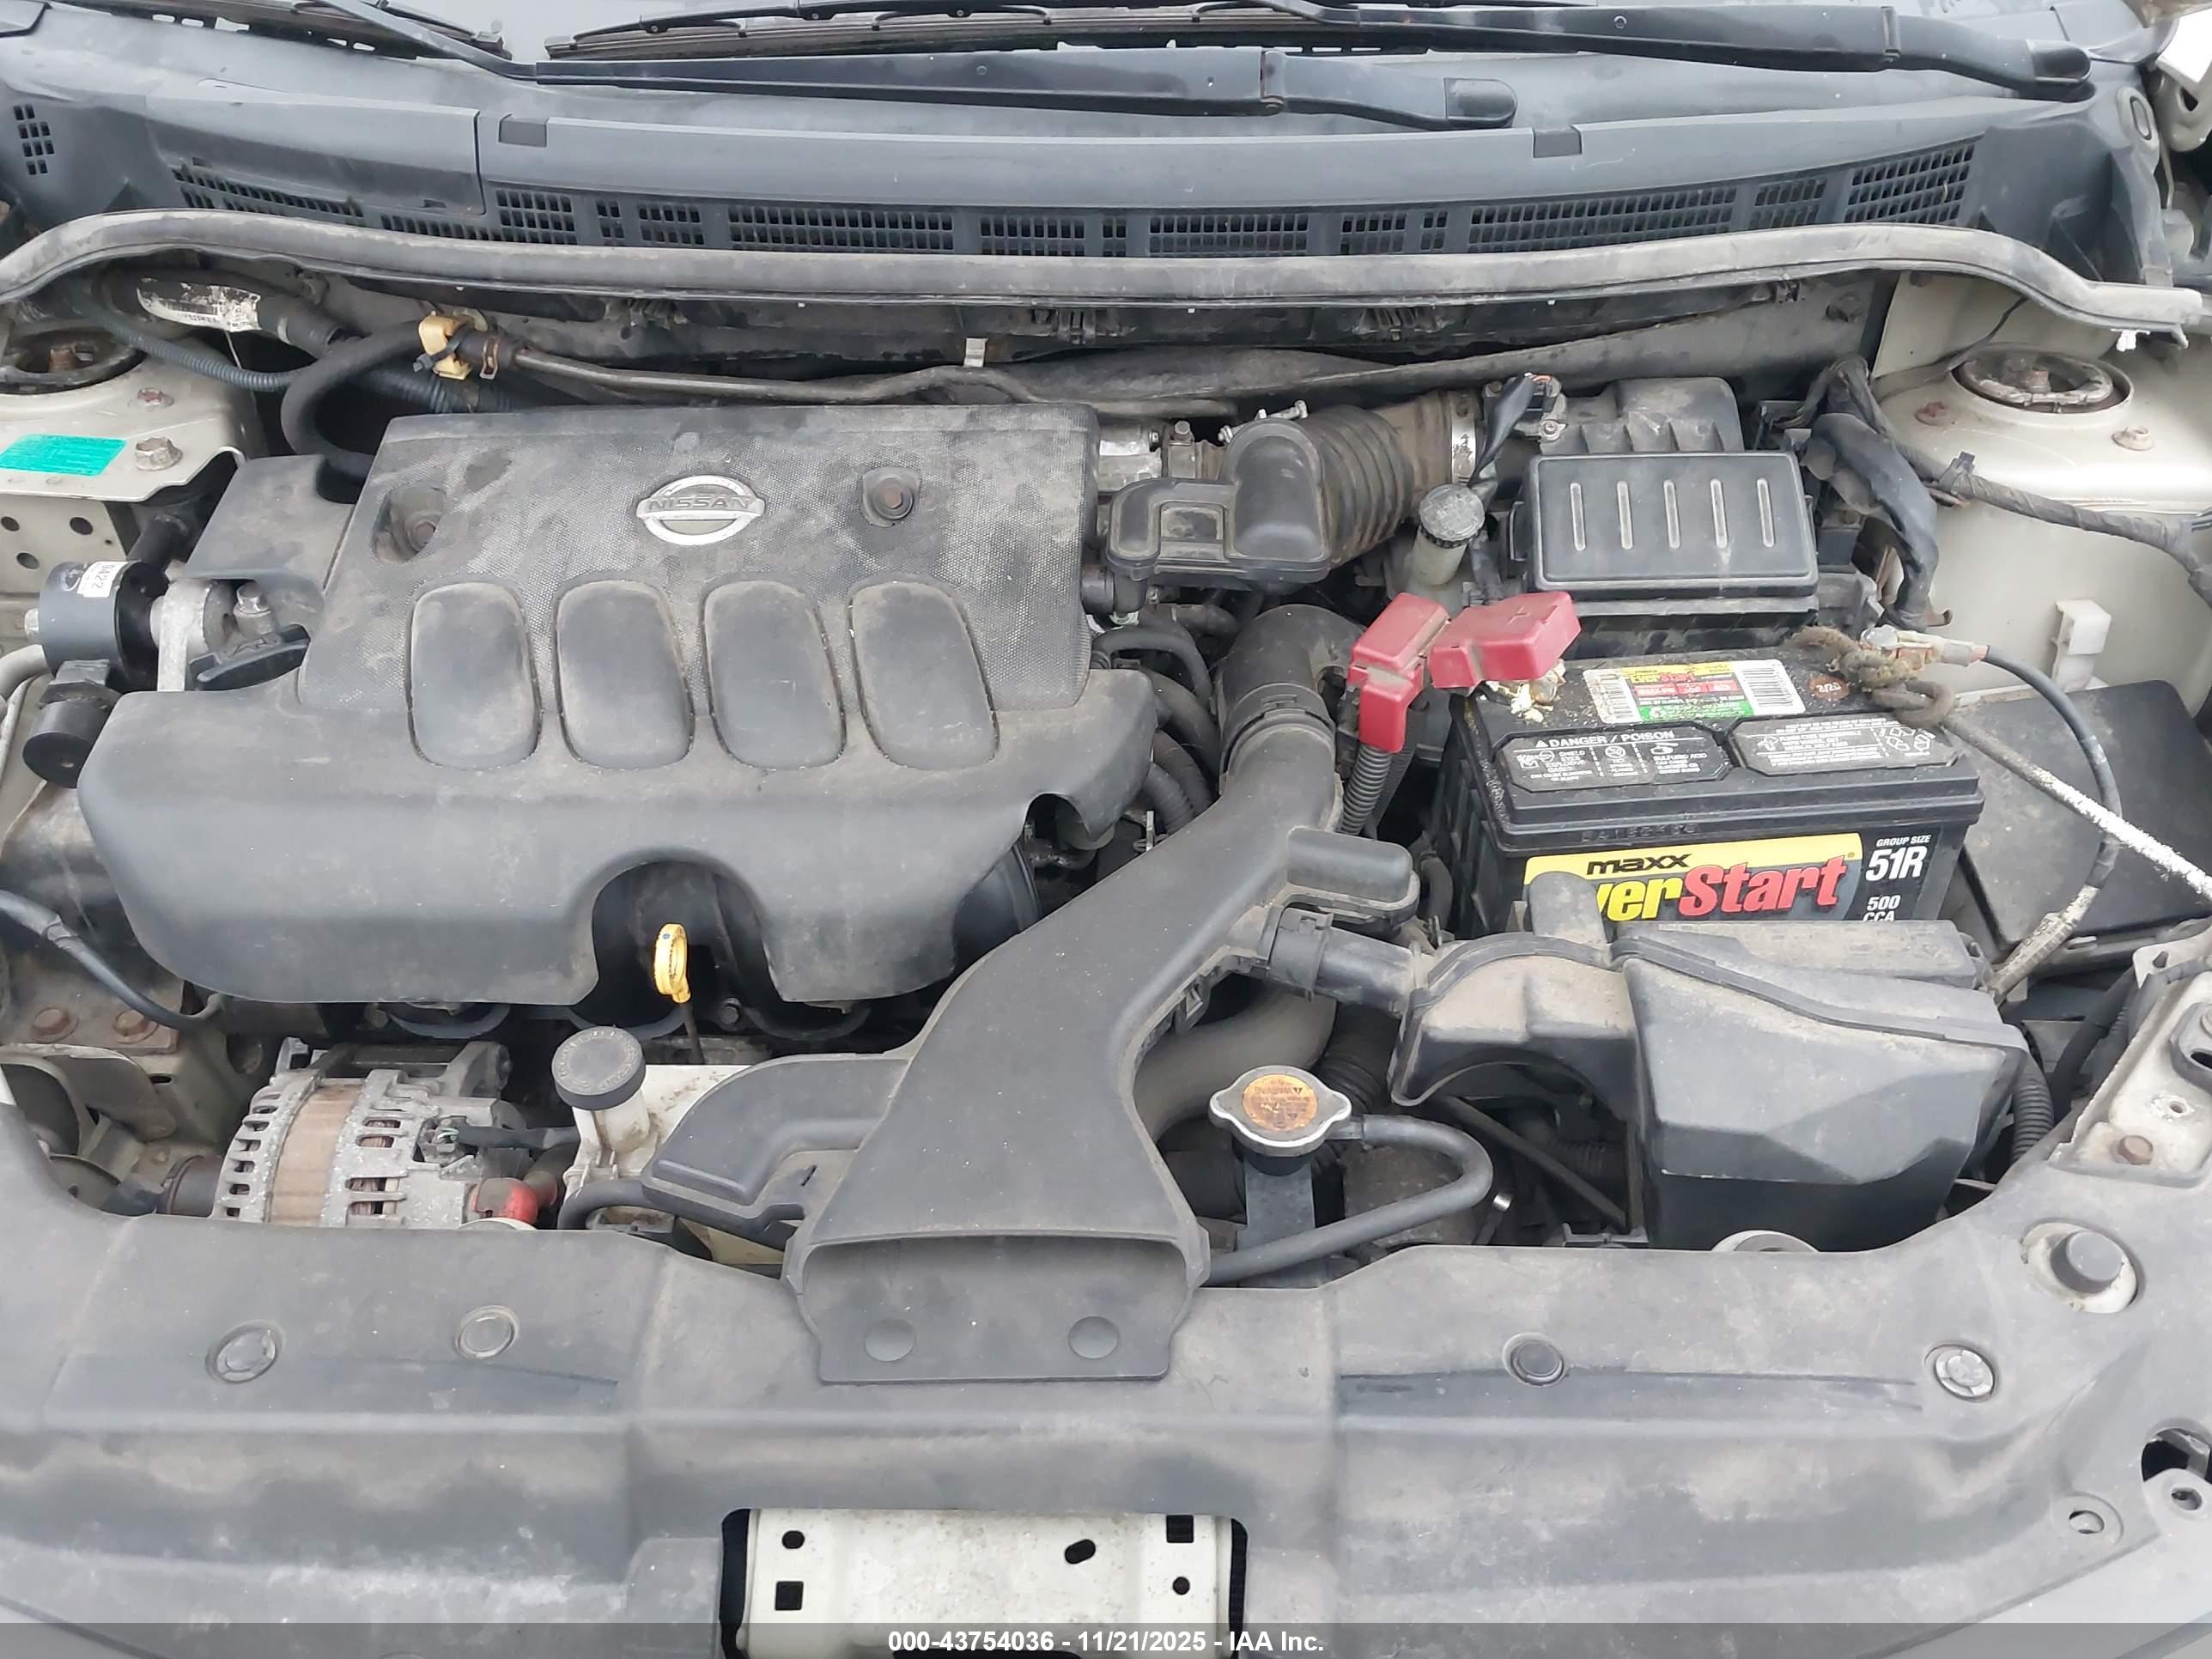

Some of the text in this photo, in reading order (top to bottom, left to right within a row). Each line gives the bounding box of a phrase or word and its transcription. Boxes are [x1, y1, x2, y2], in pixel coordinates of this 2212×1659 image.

[648, 495, 750, 511] NISSAN
[1548, 731, 1675, 748] DANGER / POISON
[1876, 834, 1932, 848] GROUP SIZE
[1587, 854, 1693, 875] maxx
[1864, 844, 1930, 882] 51R
[1596, 855, 1846, 922] verStart
[1866, 894, 1901, 911] 500
[1862, 910, 1895, 921] CCA
